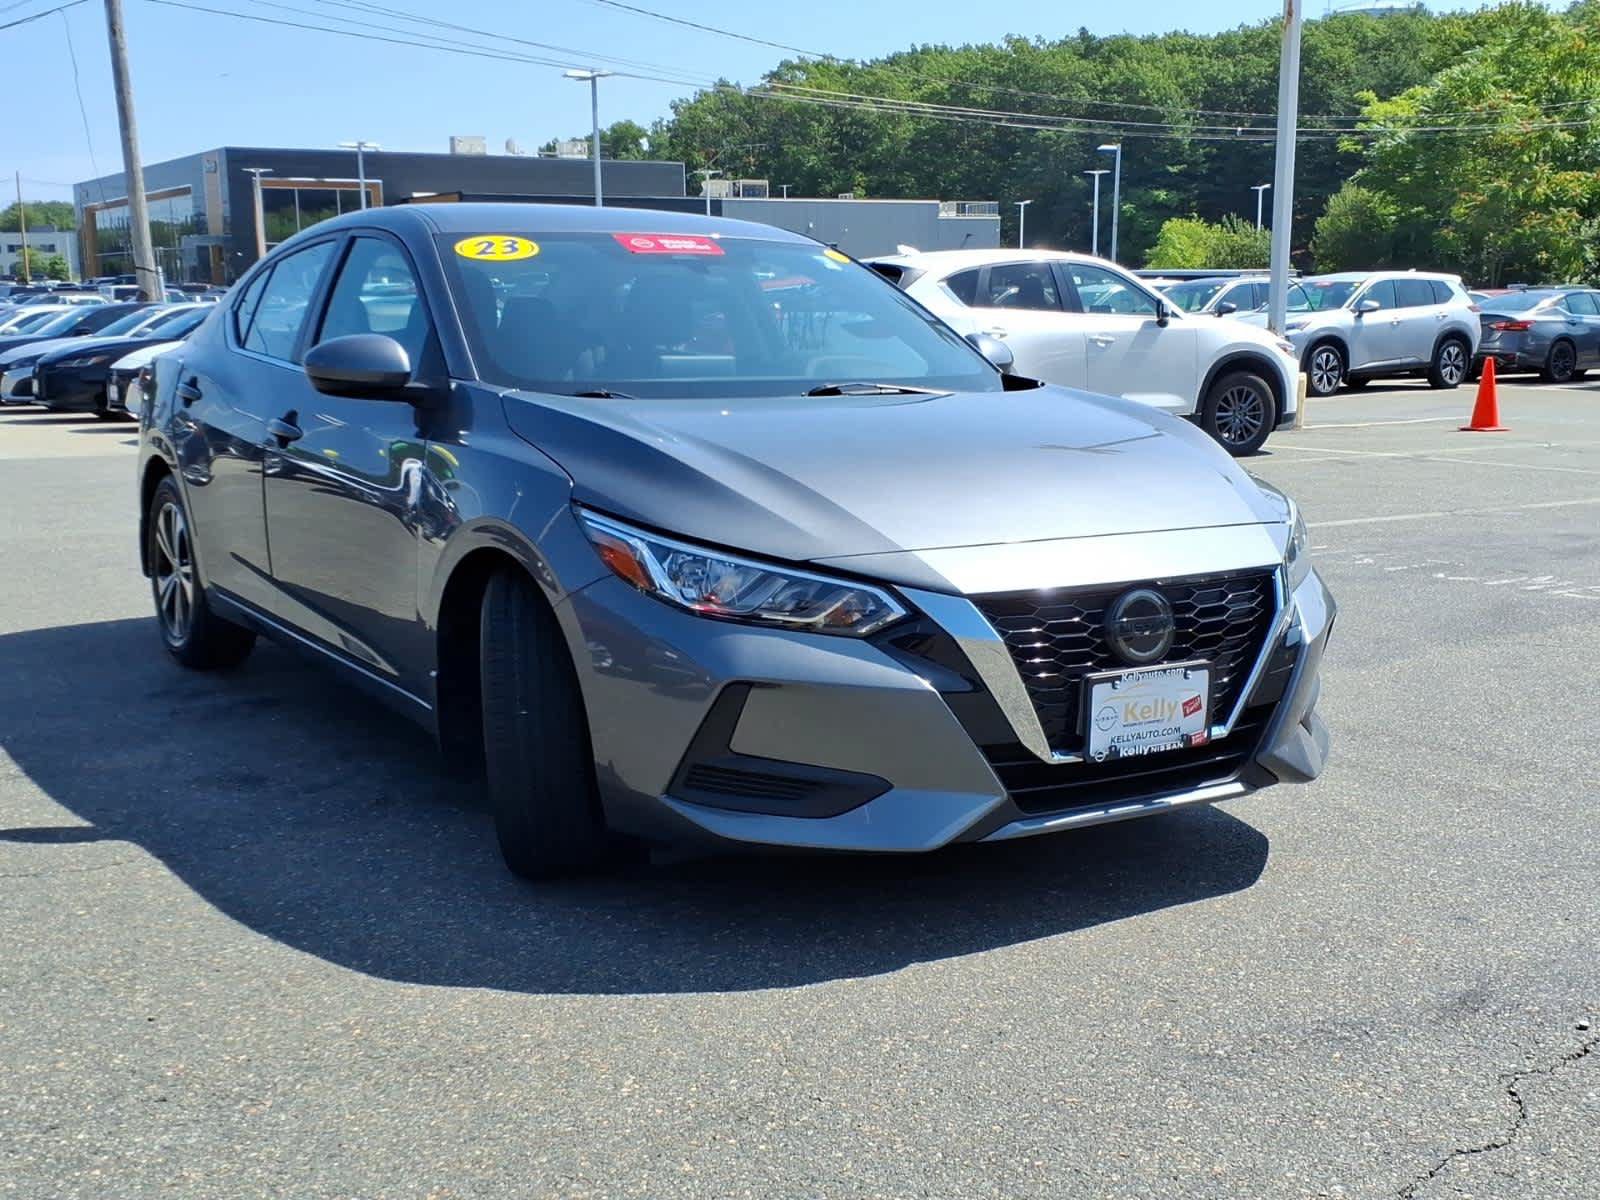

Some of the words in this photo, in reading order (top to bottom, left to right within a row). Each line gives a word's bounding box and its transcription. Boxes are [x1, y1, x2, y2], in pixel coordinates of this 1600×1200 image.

[474, 239, 519, 256] 23
[1121, 668, 1184, 682] Kellyauto.com
[1124, 697, 1178, 723] Kelly
[1110, 727, 1181, 744] KELLYAUTO.COM
[1120, 743, 1149, 757] Kelly
[1150, 742, 1183, 753] NISSAN
